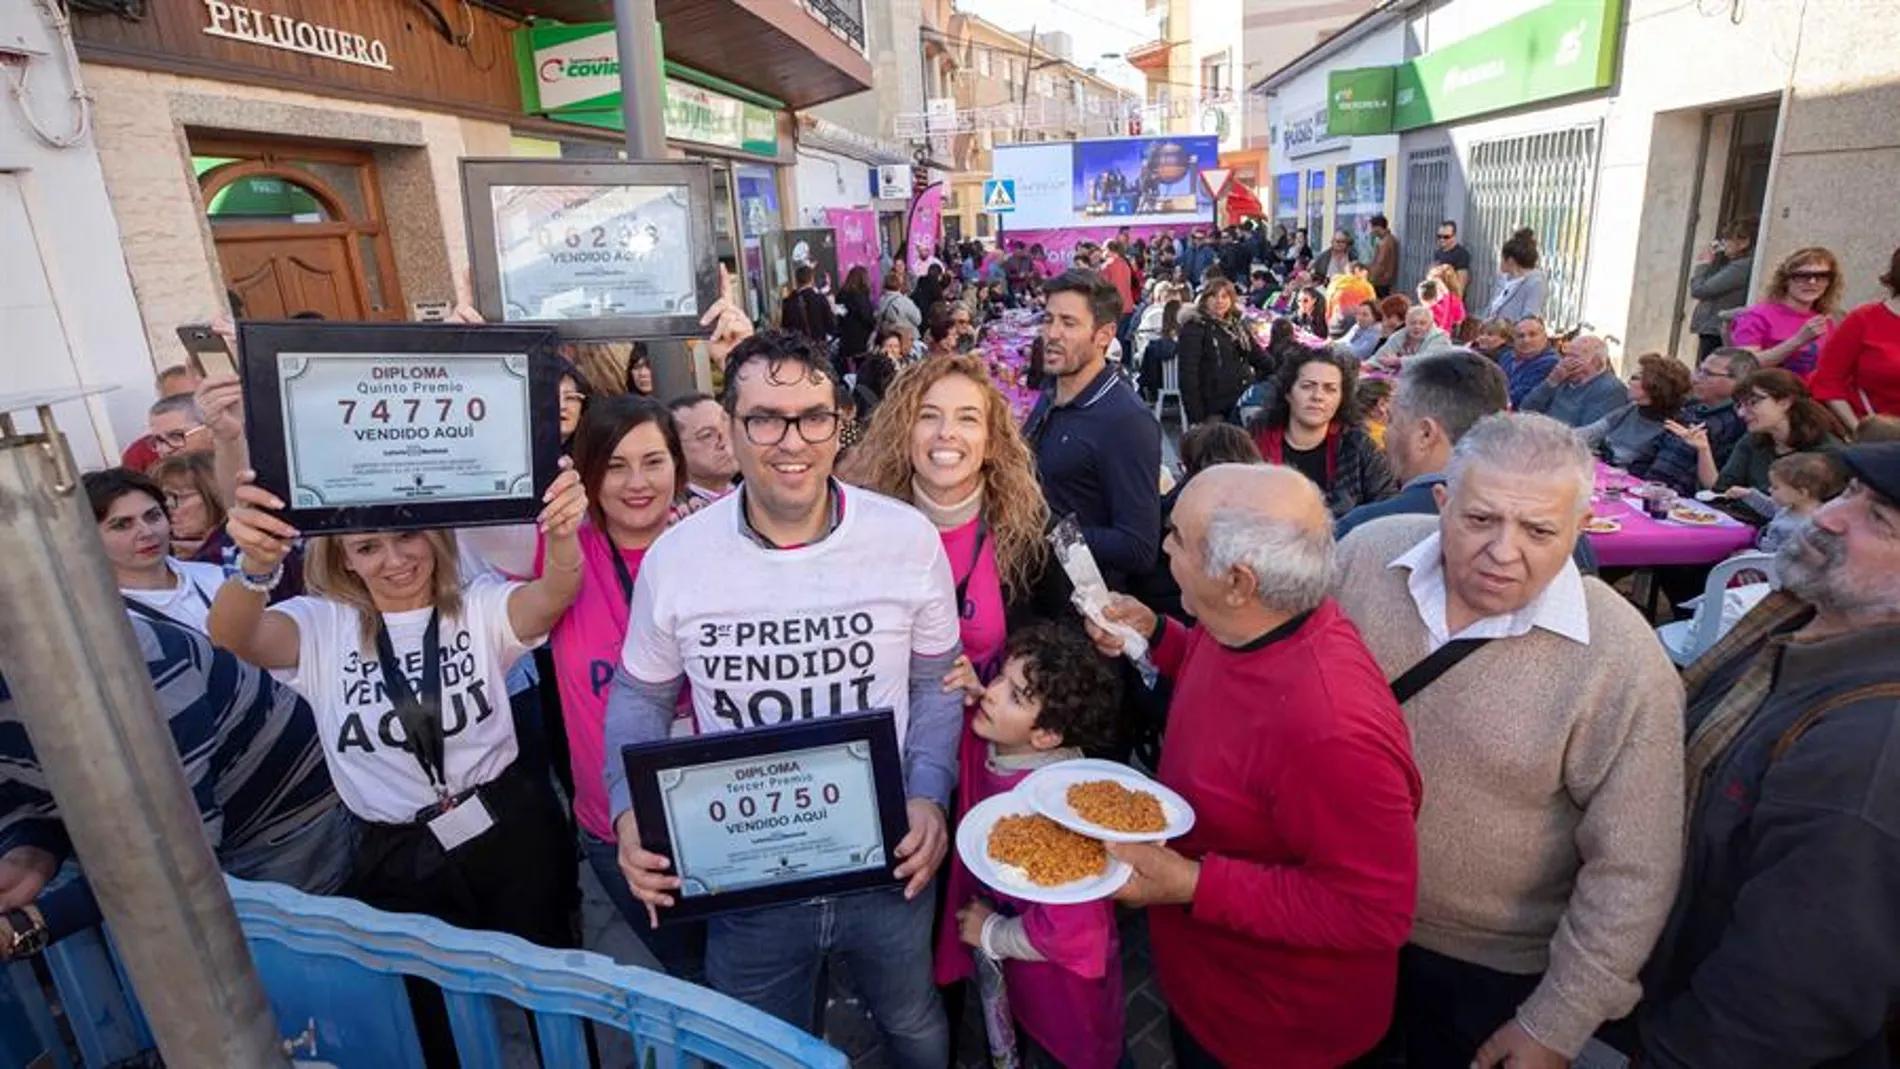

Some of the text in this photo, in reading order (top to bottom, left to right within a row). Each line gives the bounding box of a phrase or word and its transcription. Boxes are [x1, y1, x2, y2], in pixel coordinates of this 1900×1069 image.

[204, 0, 391, 66] PELUQUERO
[372, 366, 448, 381] DIPLOMA
[357, 381, 464, 394] Quinto Premio
[354, 424, 474, 441] VENDIDO AQUÍ
[736, 612, 874, 648] PREMIO
[703, 640, 875, 682] VENDIDO
[735, 761, 801, 781] DIPLOMA
[726, 773, 813, 794] Tercer Premio
[726, 809, 829, 835] VENDIDO AQUÍ
